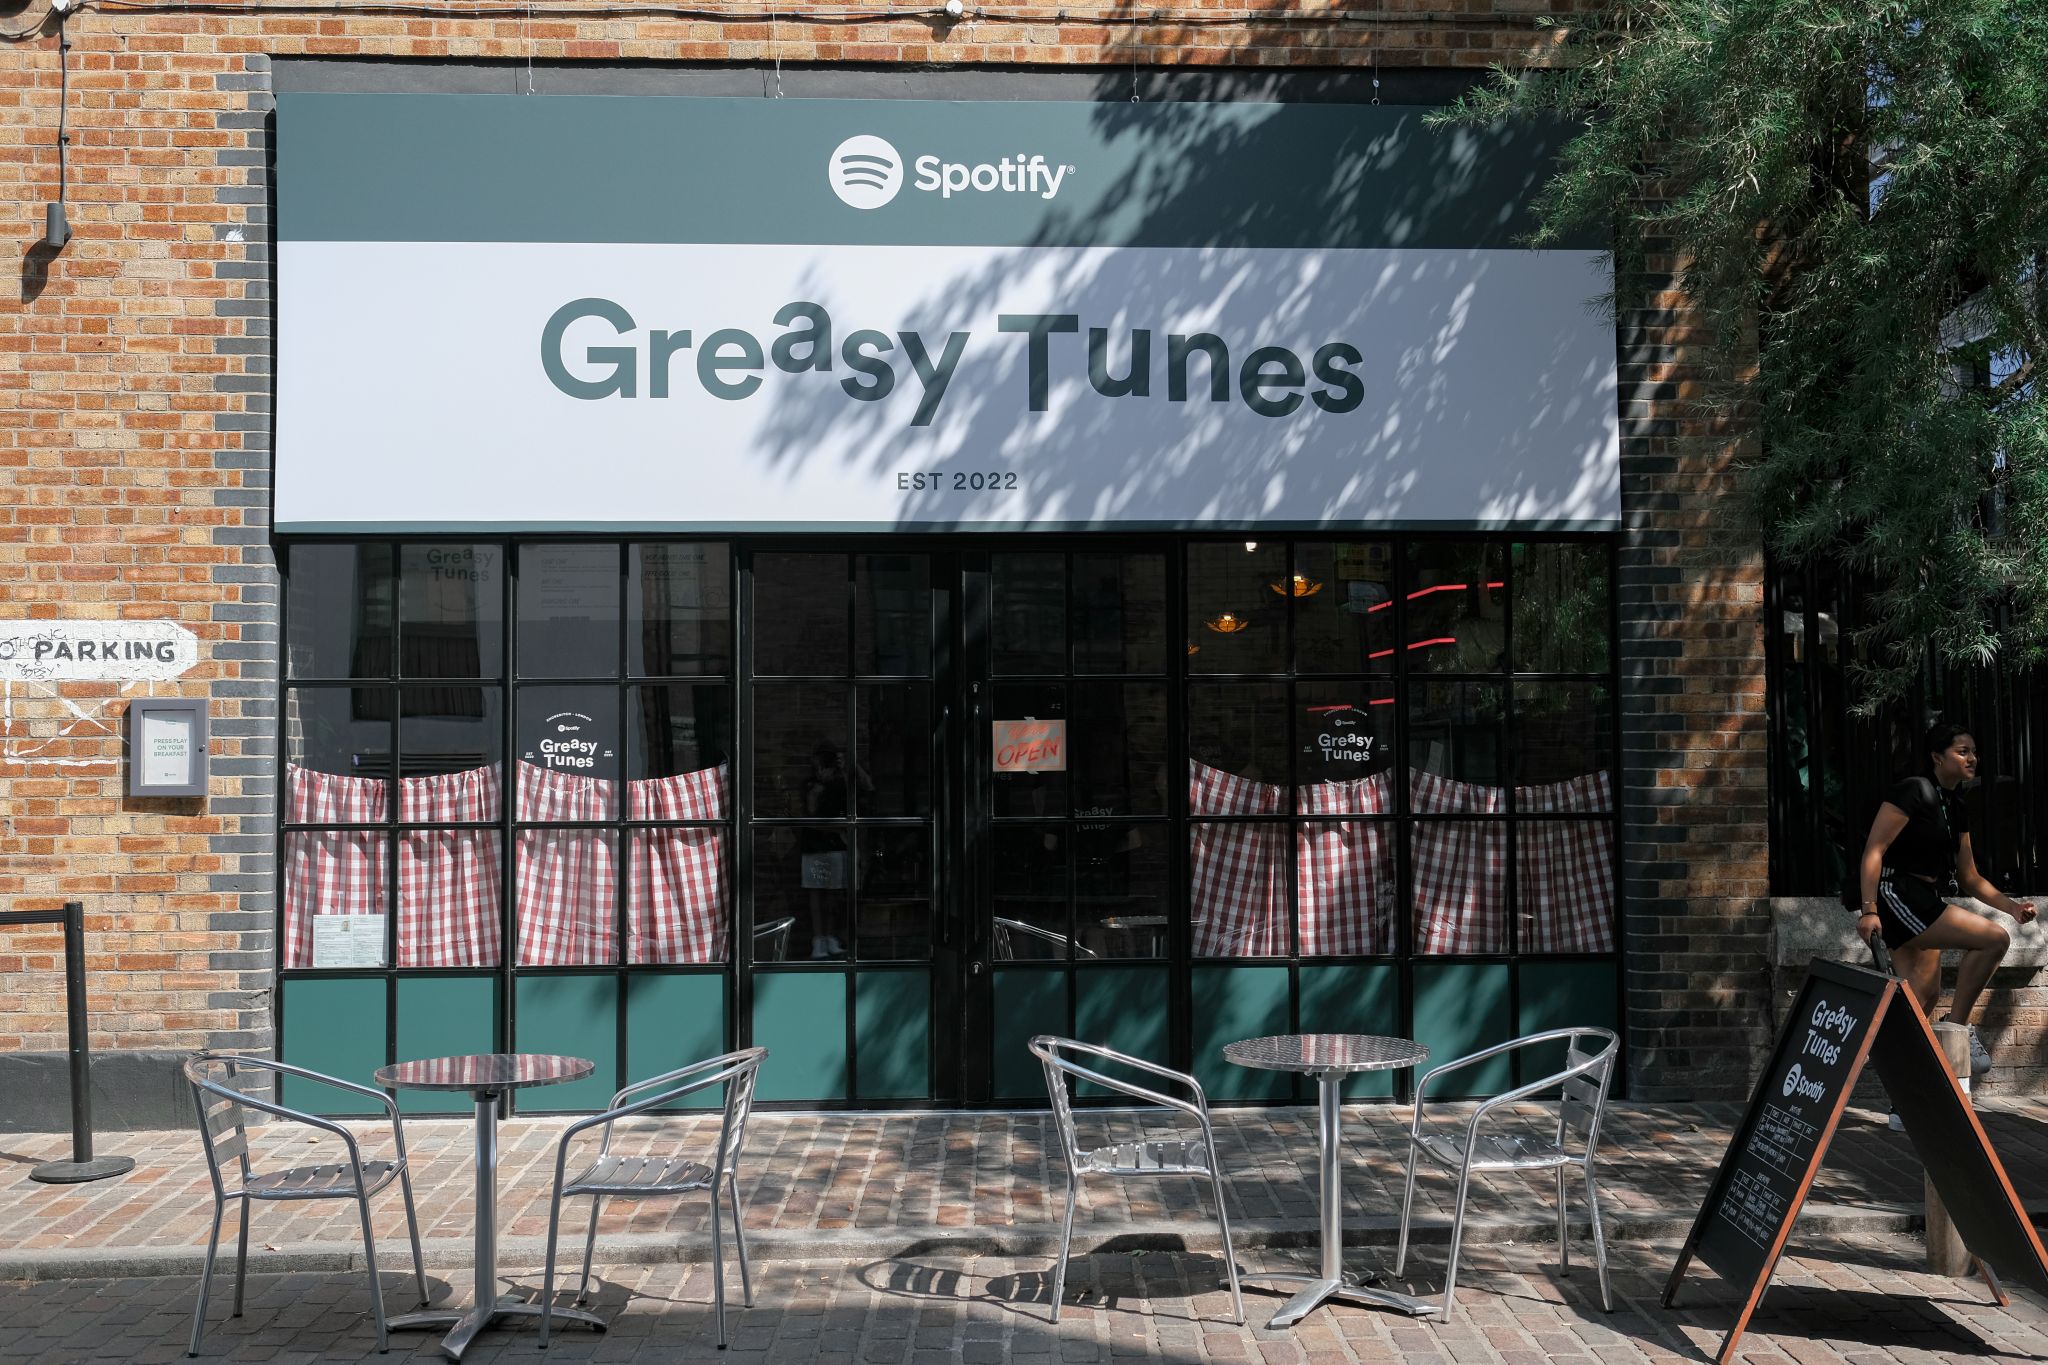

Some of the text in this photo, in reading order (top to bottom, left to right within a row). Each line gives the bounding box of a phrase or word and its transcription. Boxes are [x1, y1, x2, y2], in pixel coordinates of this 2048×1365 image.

[540, 297, 1365, 427] Greasy Tunes
[898, 472, 1018, 490] EST 2022
[427, 548, 494, 567] Greasy
[431, 566, 489, 582] Tunes
[34, 640, 175, 662] PARKING
[540, 738, 598, 755] Greasy
[1318, 733, 1374, 749] Greasy
[543, 753, 594, 768] Tunes
[997, 737, 1061, 766] OPEN
[1321, 748, 1371, 762] Tunes
[1811, 999, 1858, 1043] Greasy
[1801, 1028, 1841, 1066] Tunes
[1796, 1074, 1826, 1104] Spotify
